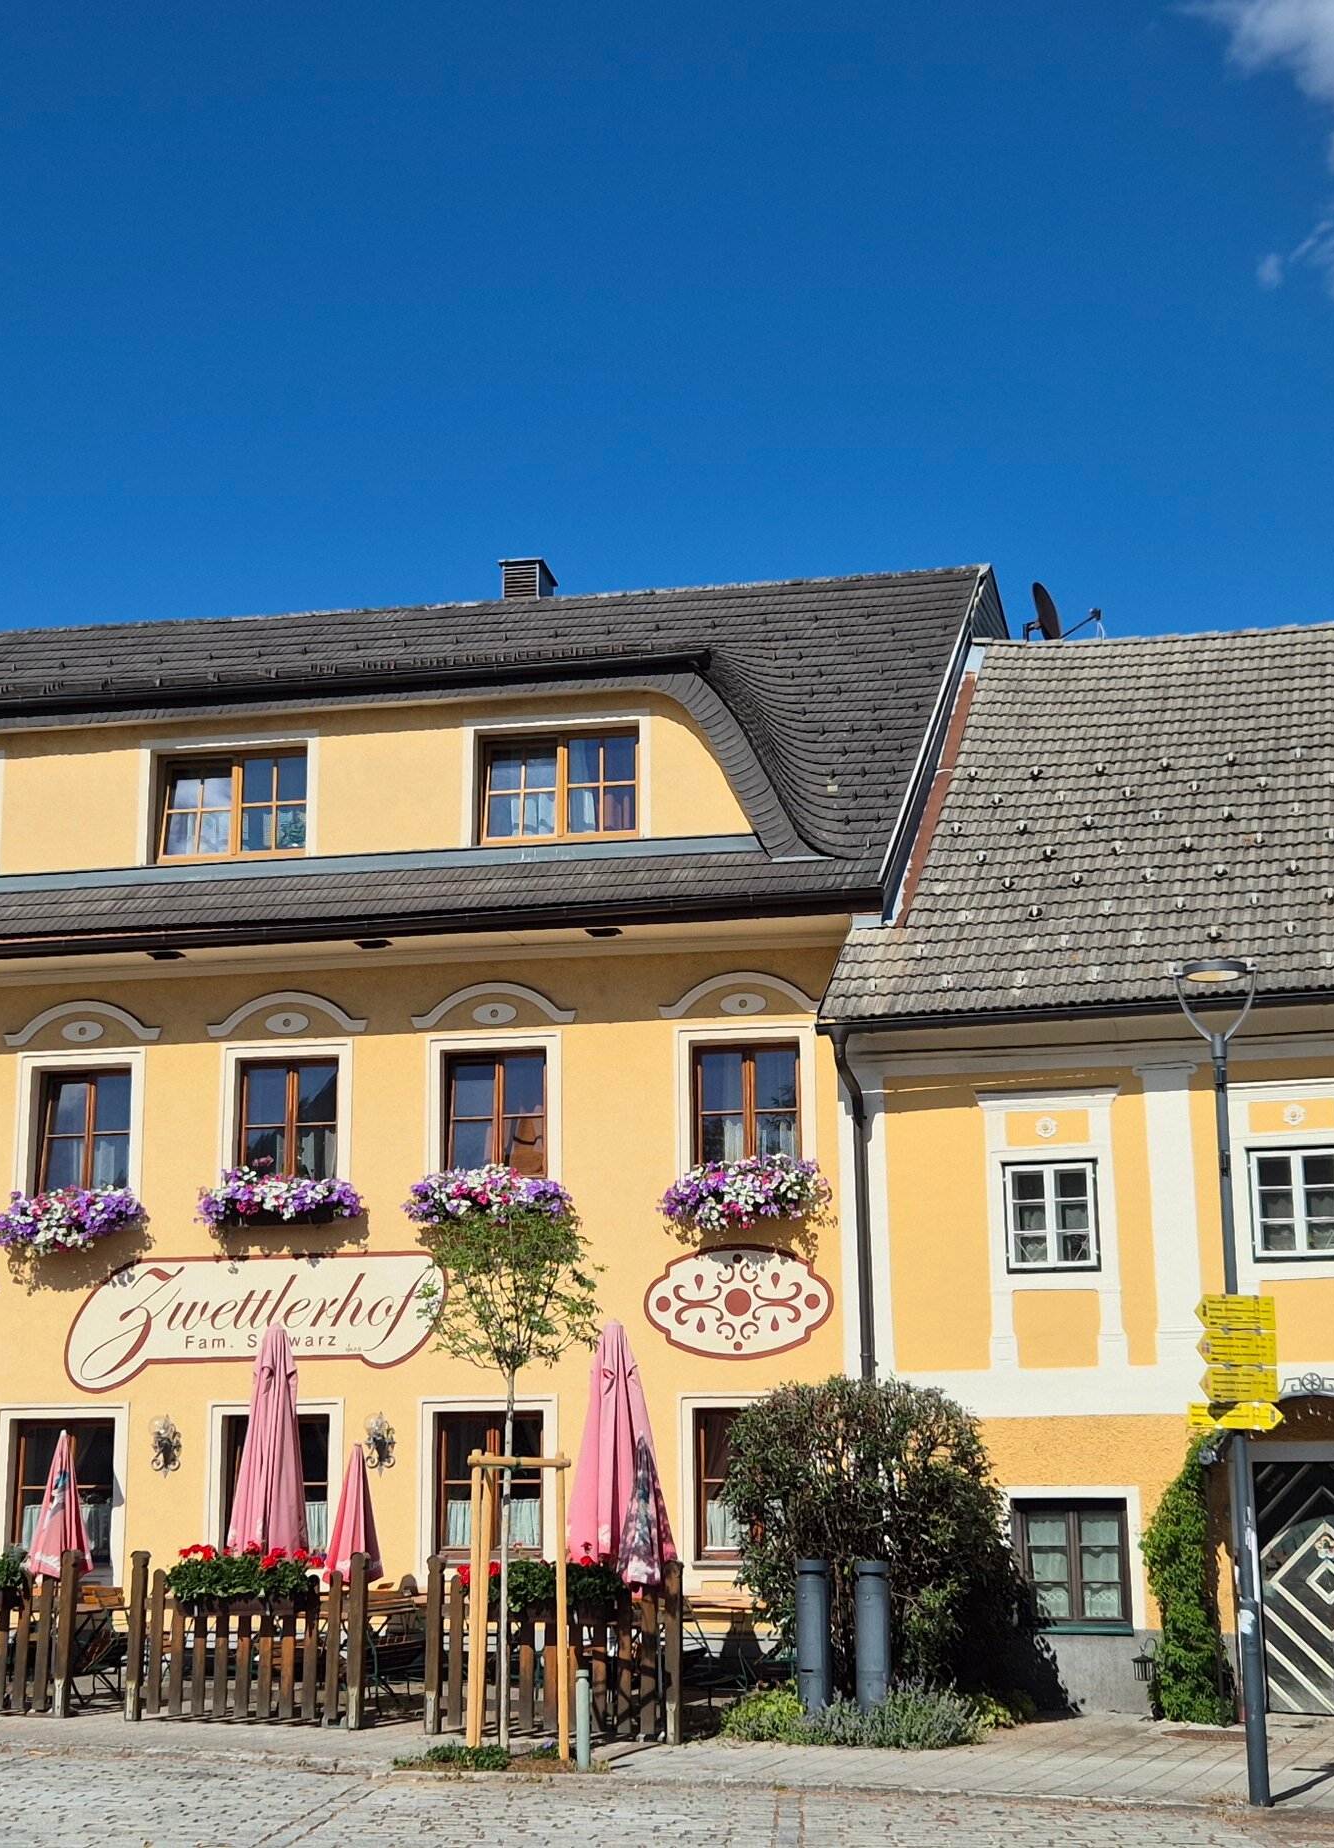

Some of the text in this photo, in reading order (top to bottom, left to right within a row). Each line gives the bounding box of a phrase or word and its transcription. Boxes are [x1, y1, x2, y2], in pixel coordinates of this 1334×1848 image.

[80, 1265, 435, 1381] Zwettlerhof
[185, 1335, 234, 1349] Fam.
[247, 1333, 337, 1348] Swarz
